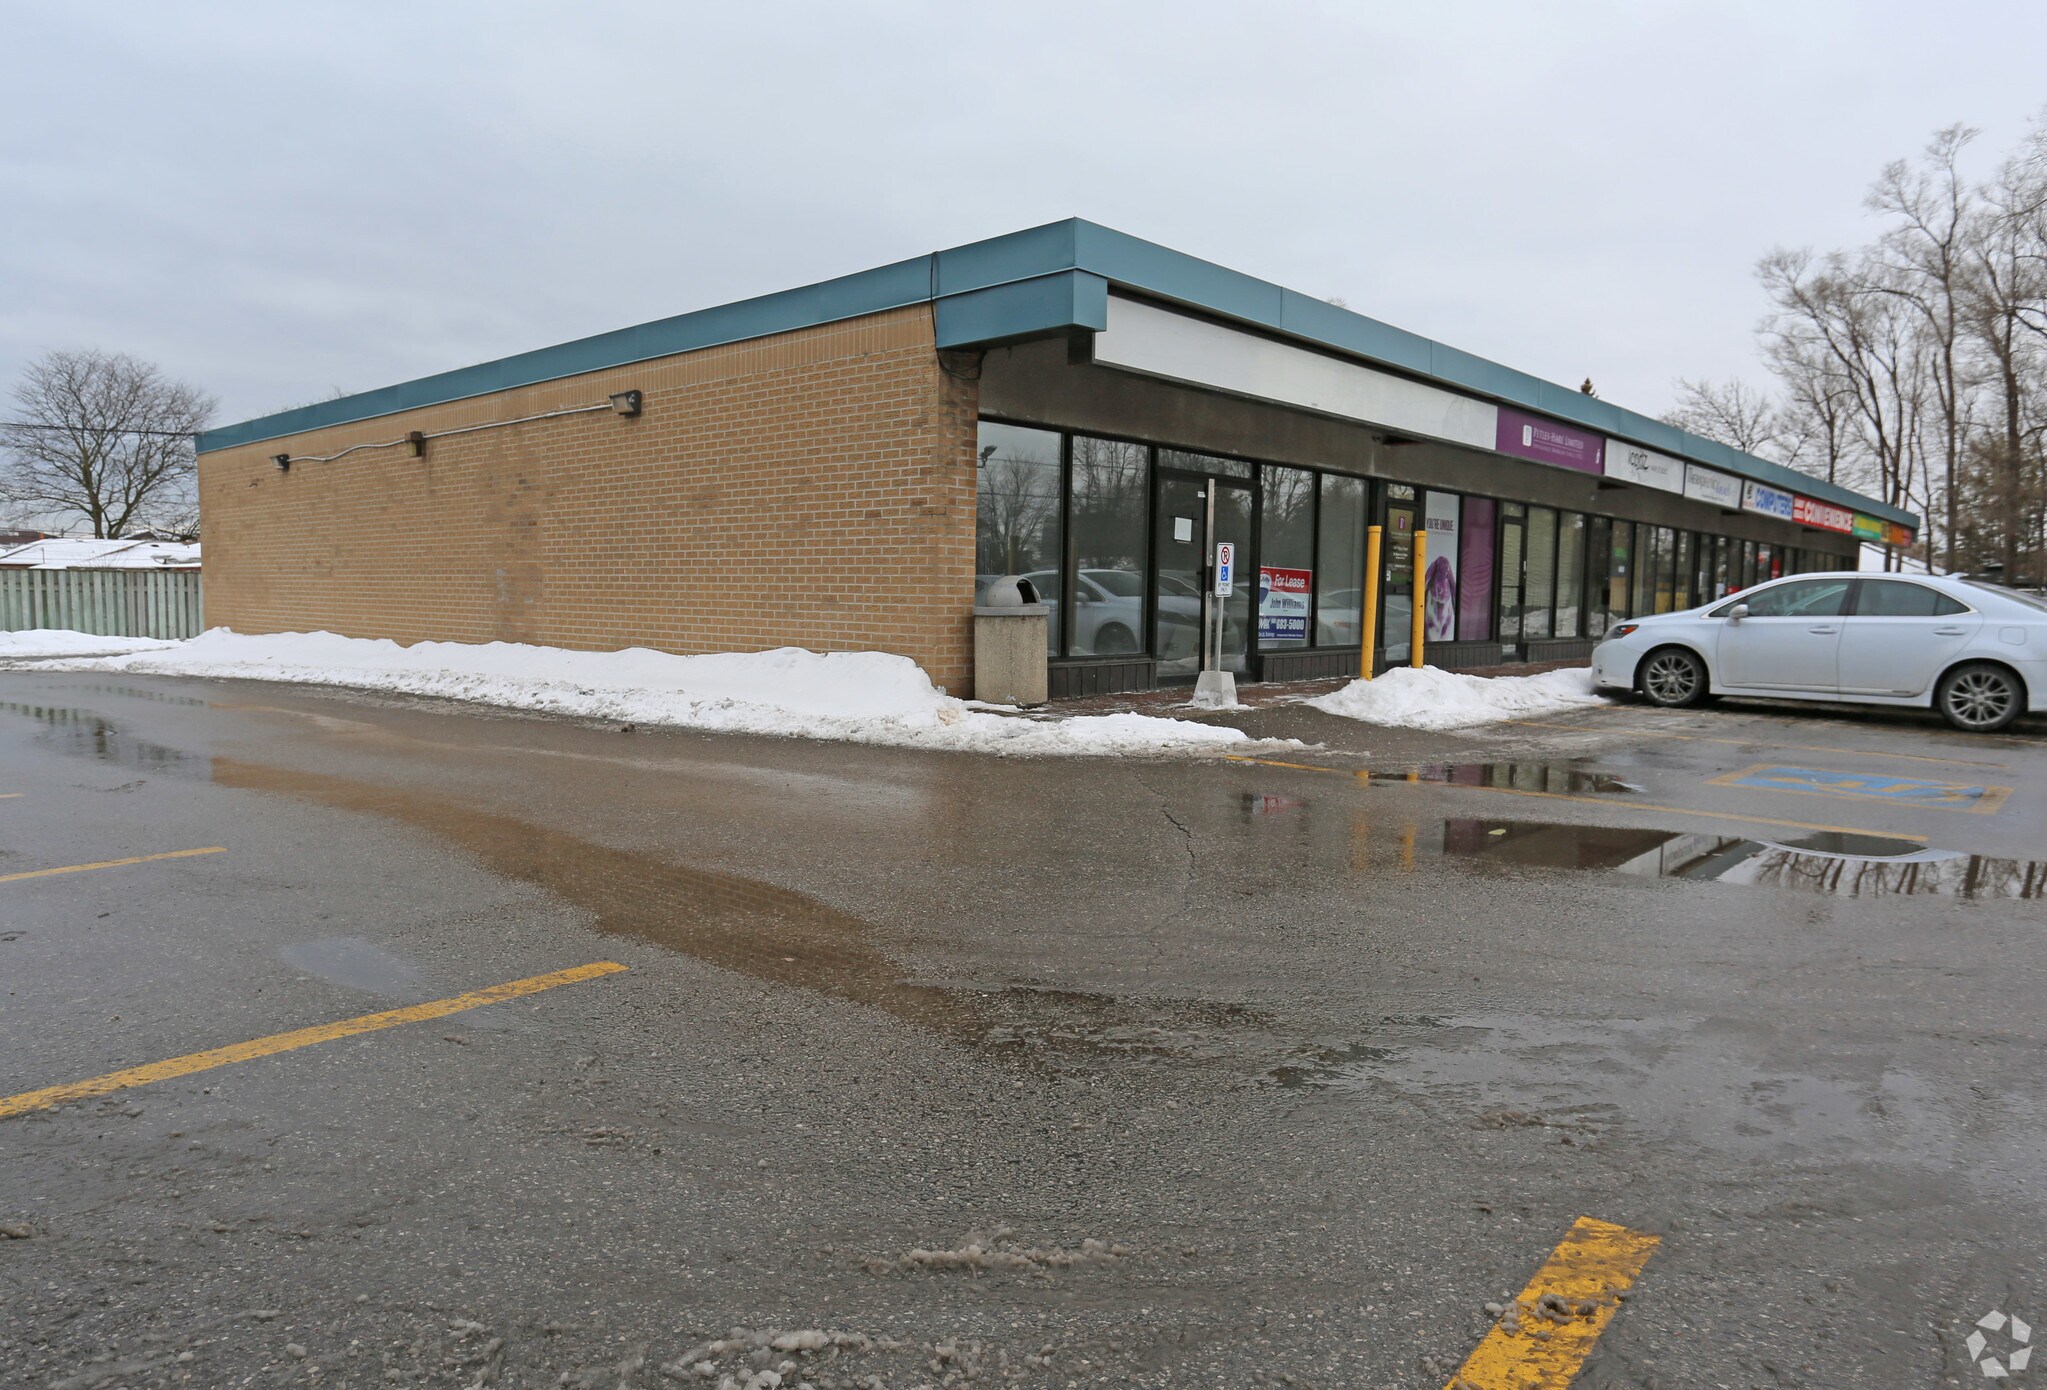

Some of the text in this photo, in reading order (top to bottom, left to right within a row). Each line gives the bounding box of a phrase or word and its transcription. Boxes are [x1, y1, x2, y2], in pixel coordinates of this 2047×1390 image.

[1755, 487, 1792, 516] COMPUTERS
[1804, 501, 1853, 531] CONVENIENCE
[1274, 574, 1285, 587] For
[1285, 575, 1305, 588] Lease
[1270, 598, 1305, 610] John Williams
